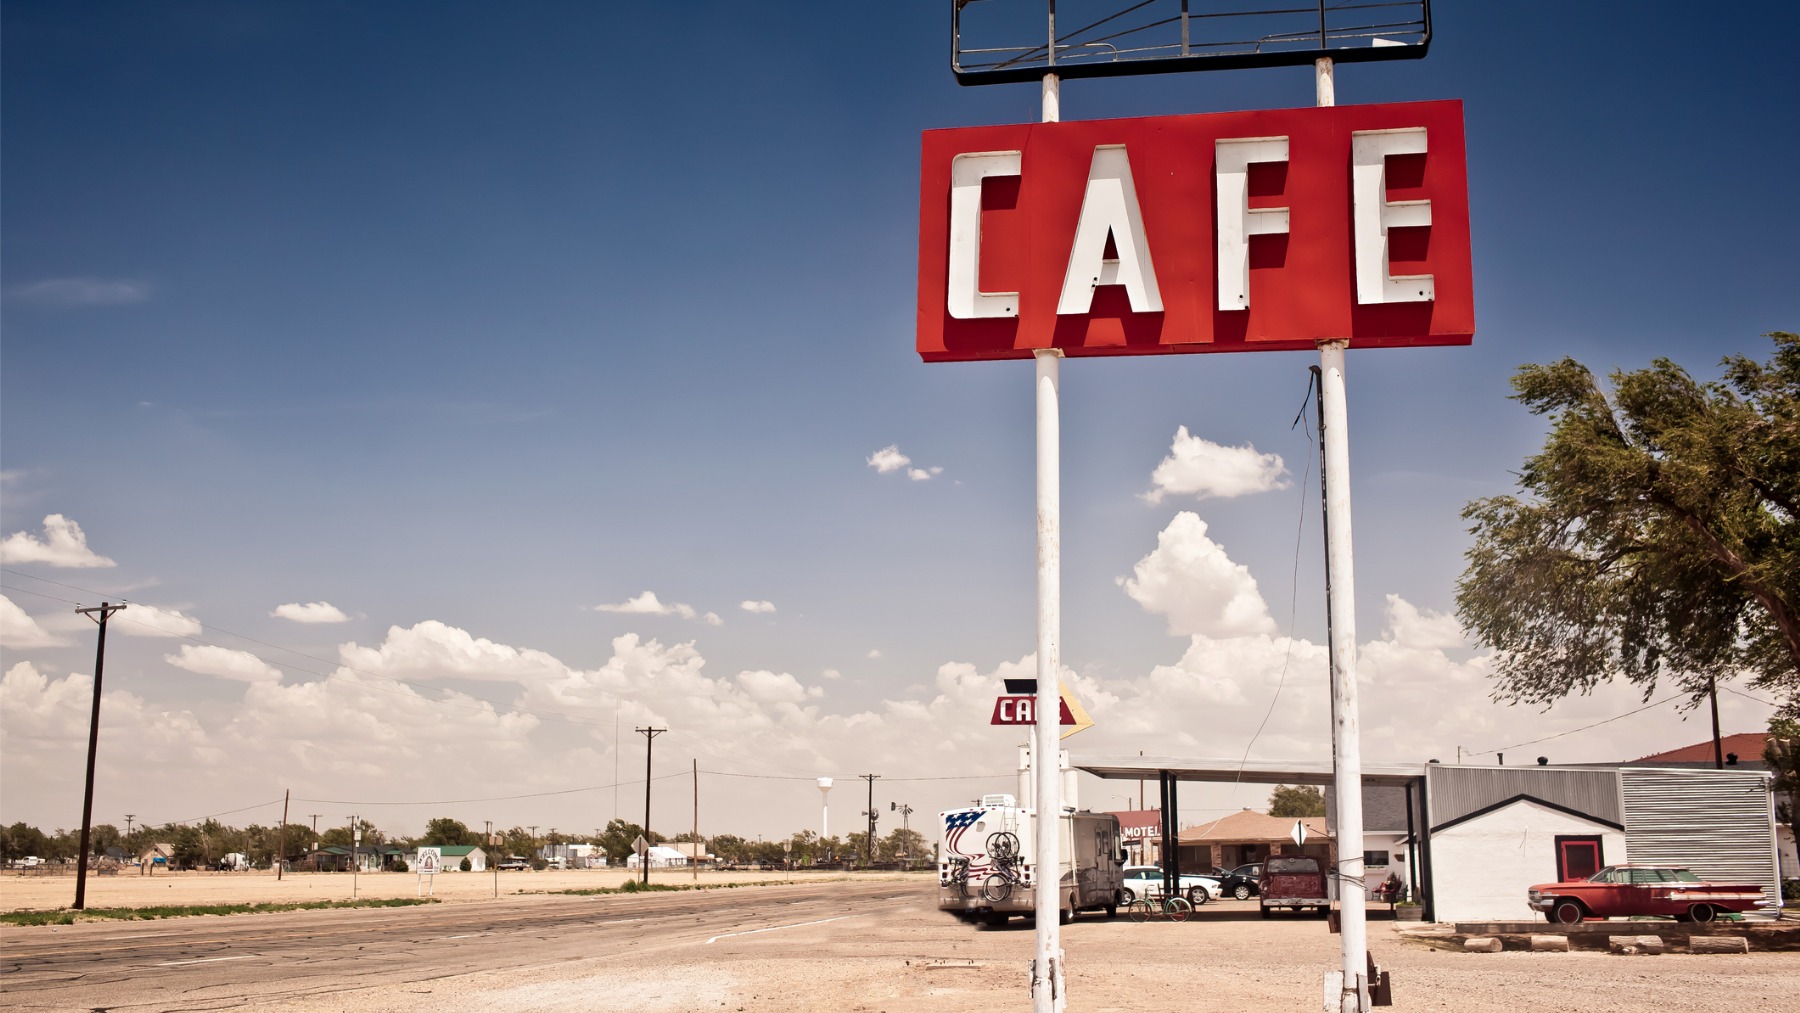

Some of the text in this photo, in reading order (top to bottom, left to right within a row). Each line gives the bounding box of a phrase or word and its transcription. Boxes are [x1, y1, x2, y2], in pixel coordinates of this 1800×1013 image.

[947, 126, 1435, 320] CAFE
[1000, 699, 1061, 722] CA
[1124, 825, 1161, 837] MOTEL
